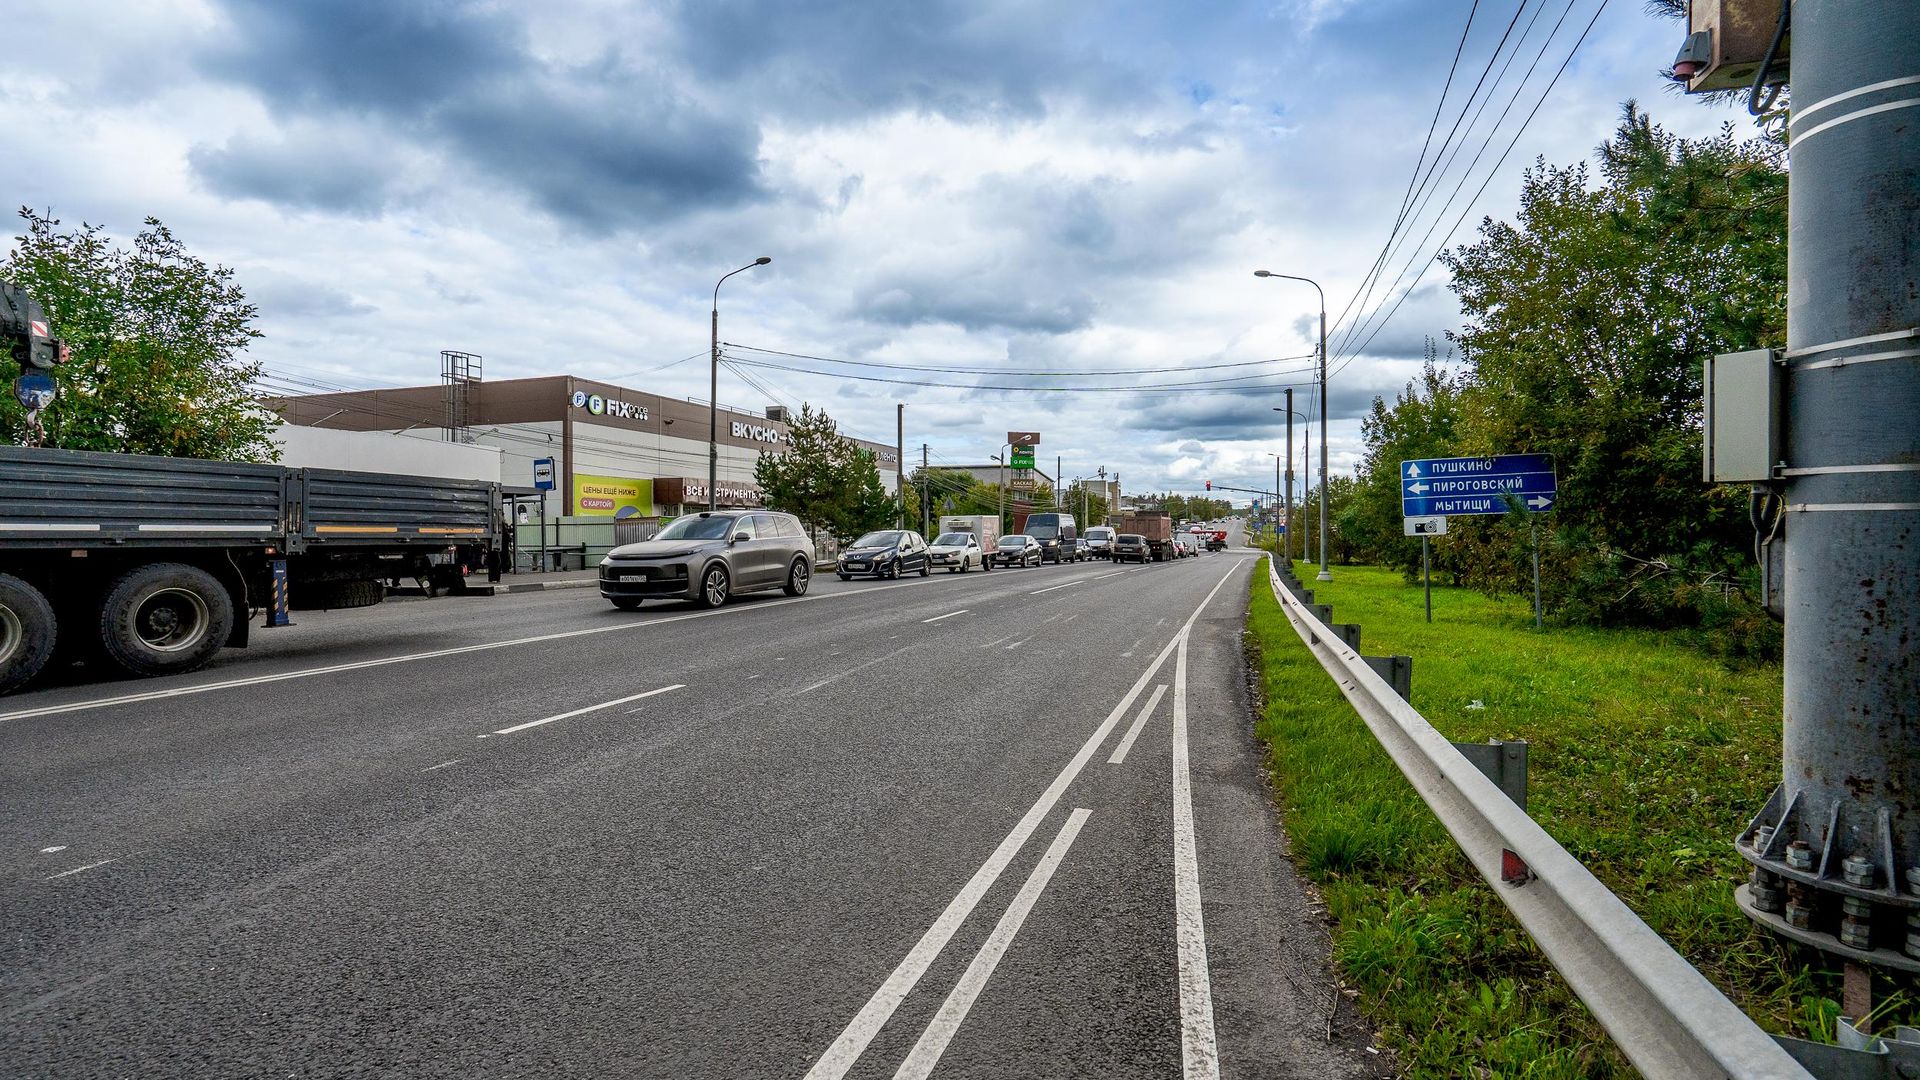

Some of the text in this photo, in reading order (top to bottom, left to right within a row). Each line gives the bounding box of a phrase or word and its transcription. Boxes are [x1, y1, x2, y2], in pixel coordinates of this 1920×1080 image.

[1432, 460, 1492, 473] ПУШКИНО
[583, 486, 602, 494] ЦЕНЫ
[1433, 476, 1523, 492] ПИРОГОВСКИЙ
[1435, 499, 1491, 512] МЫТИЩИ
